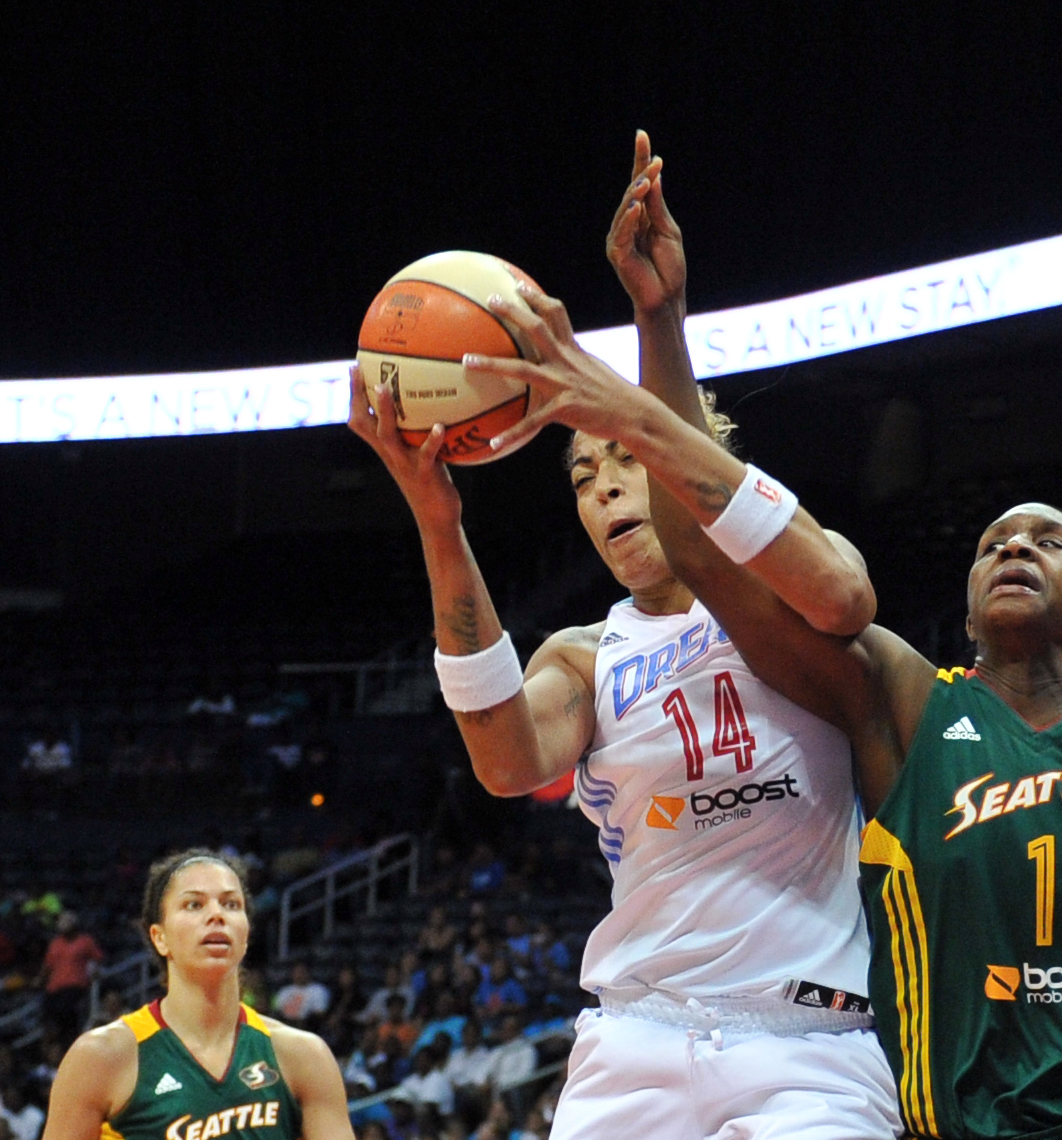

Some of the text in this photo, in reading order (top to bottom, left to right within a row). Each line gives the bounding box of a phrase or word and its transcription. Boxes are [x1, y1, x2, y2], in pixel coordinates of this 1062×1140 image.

[740, 319, 773, 362] A
[786, 290, 885, 356] NEW
[95, 391, 130, 438] A
[150, 384, 272, 435] NEW
[288, 376, 350, 426] ST
[661, 671, 757, 782] 14
[943, 731, 982, 742] adidas
[690, 774, 800, 816] boost
[694, 807, 752, 831] mobile
[1027, 834, 1056, 947] 1
